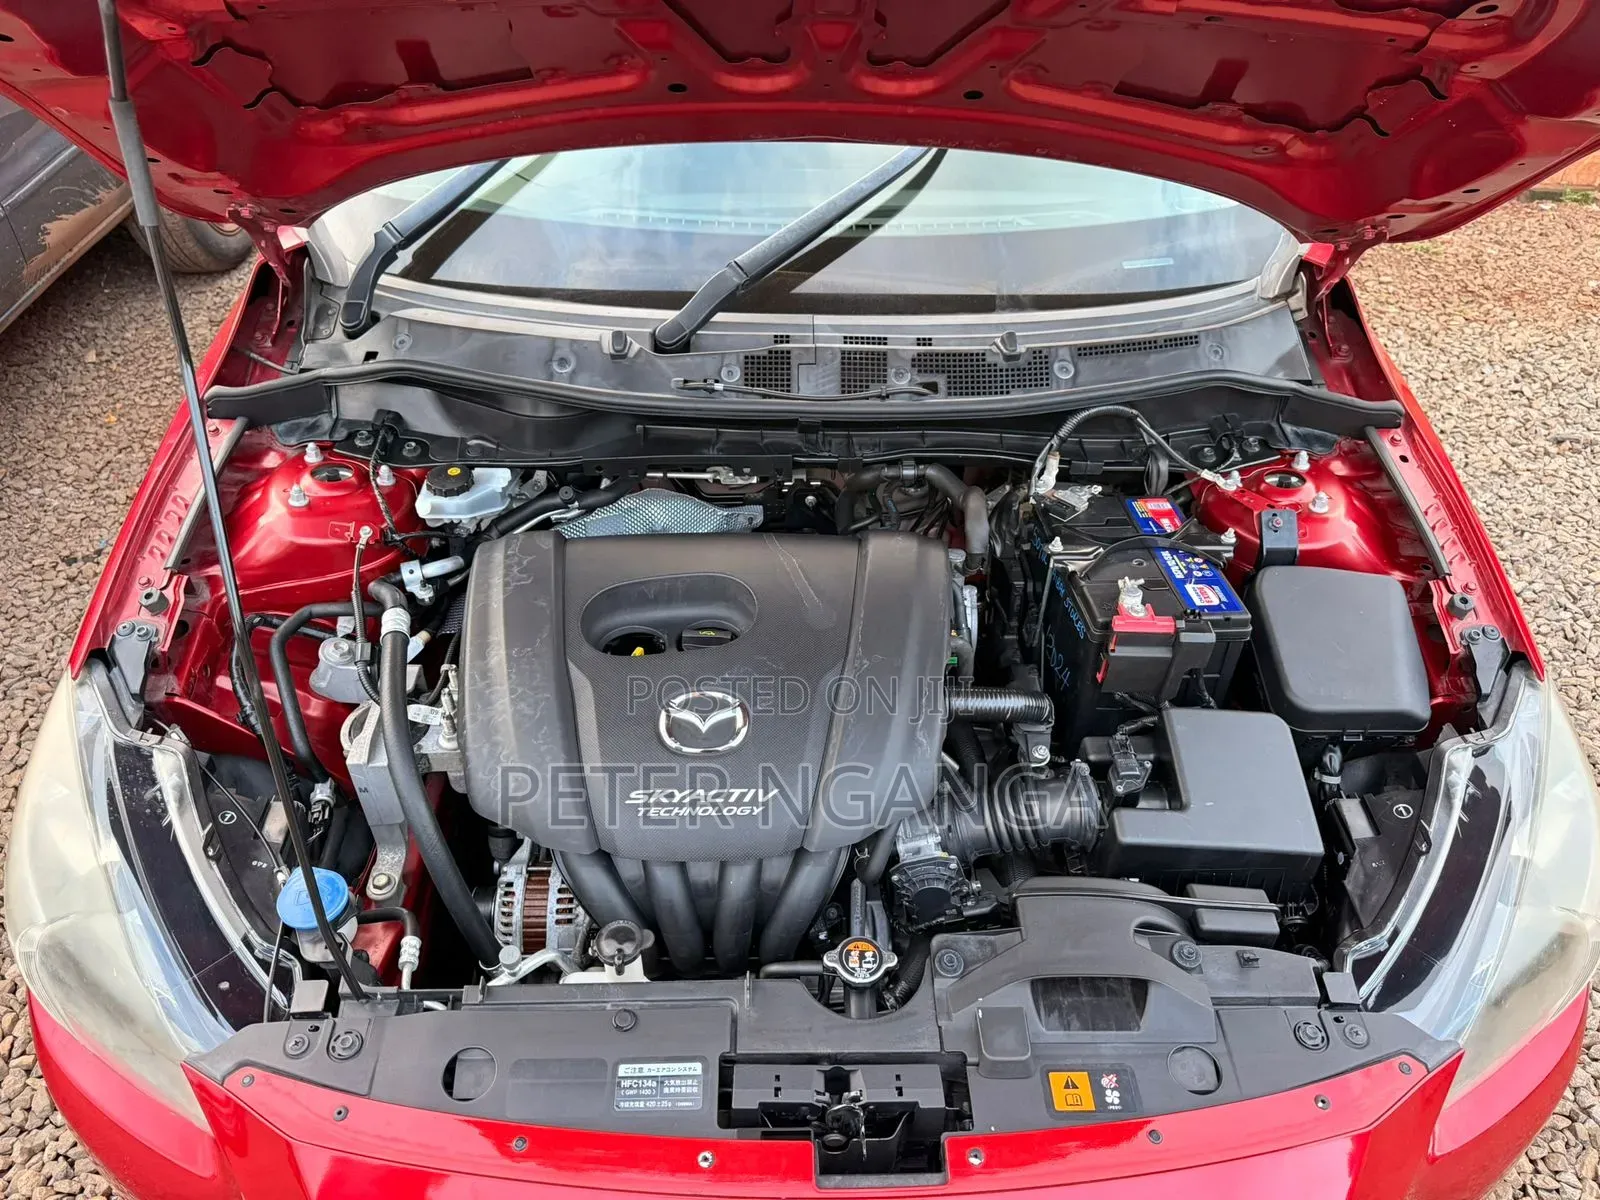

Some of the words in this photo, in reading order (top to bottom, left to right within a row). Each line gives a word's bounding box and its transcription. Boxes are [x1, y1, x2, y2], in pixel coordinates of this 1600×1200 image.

[625, 788, 780, 804] SKYACTIV
[637, 805, 765, 817] TECHNOLOGY
[620, 1079, 657, 1088] HFC134a
